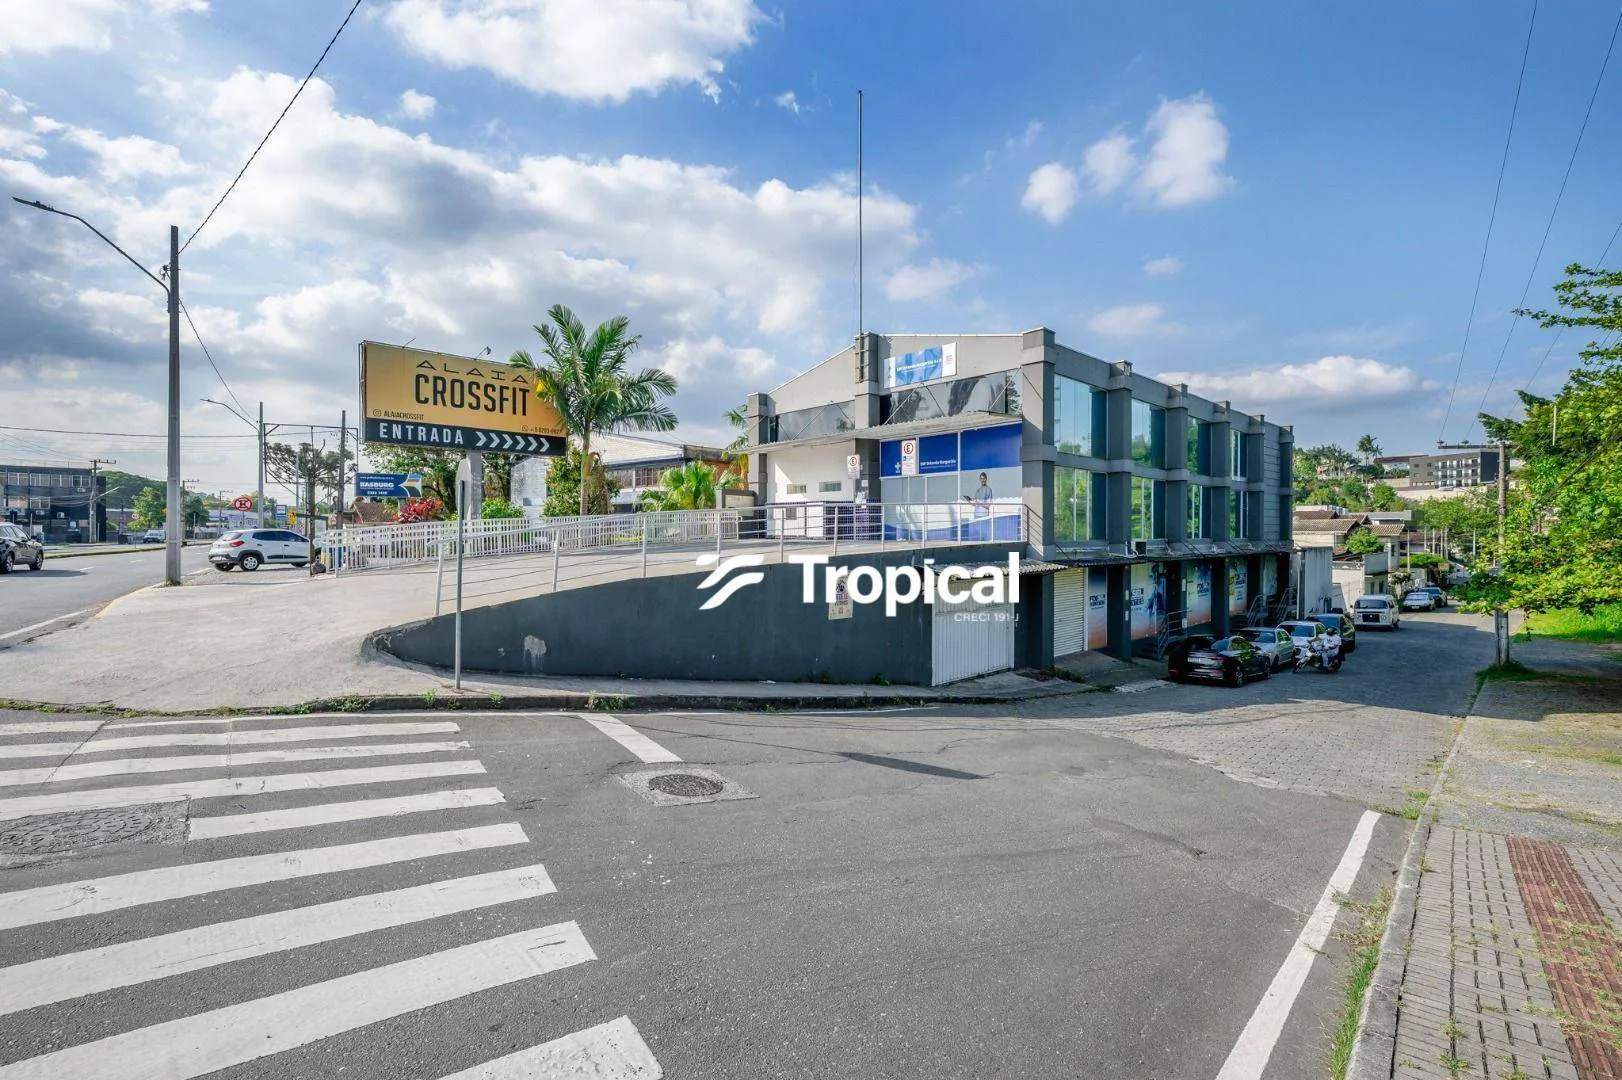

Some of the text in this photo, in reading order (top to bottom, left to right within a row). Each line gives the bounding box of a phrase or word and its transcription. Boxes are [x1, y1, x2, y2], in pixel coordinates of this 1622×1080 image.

[416, 360, 529, 384] ALAIA
[415, 373, 530, 416] CROSSFIT
[379, 422, 464, 445] ENTRADA
